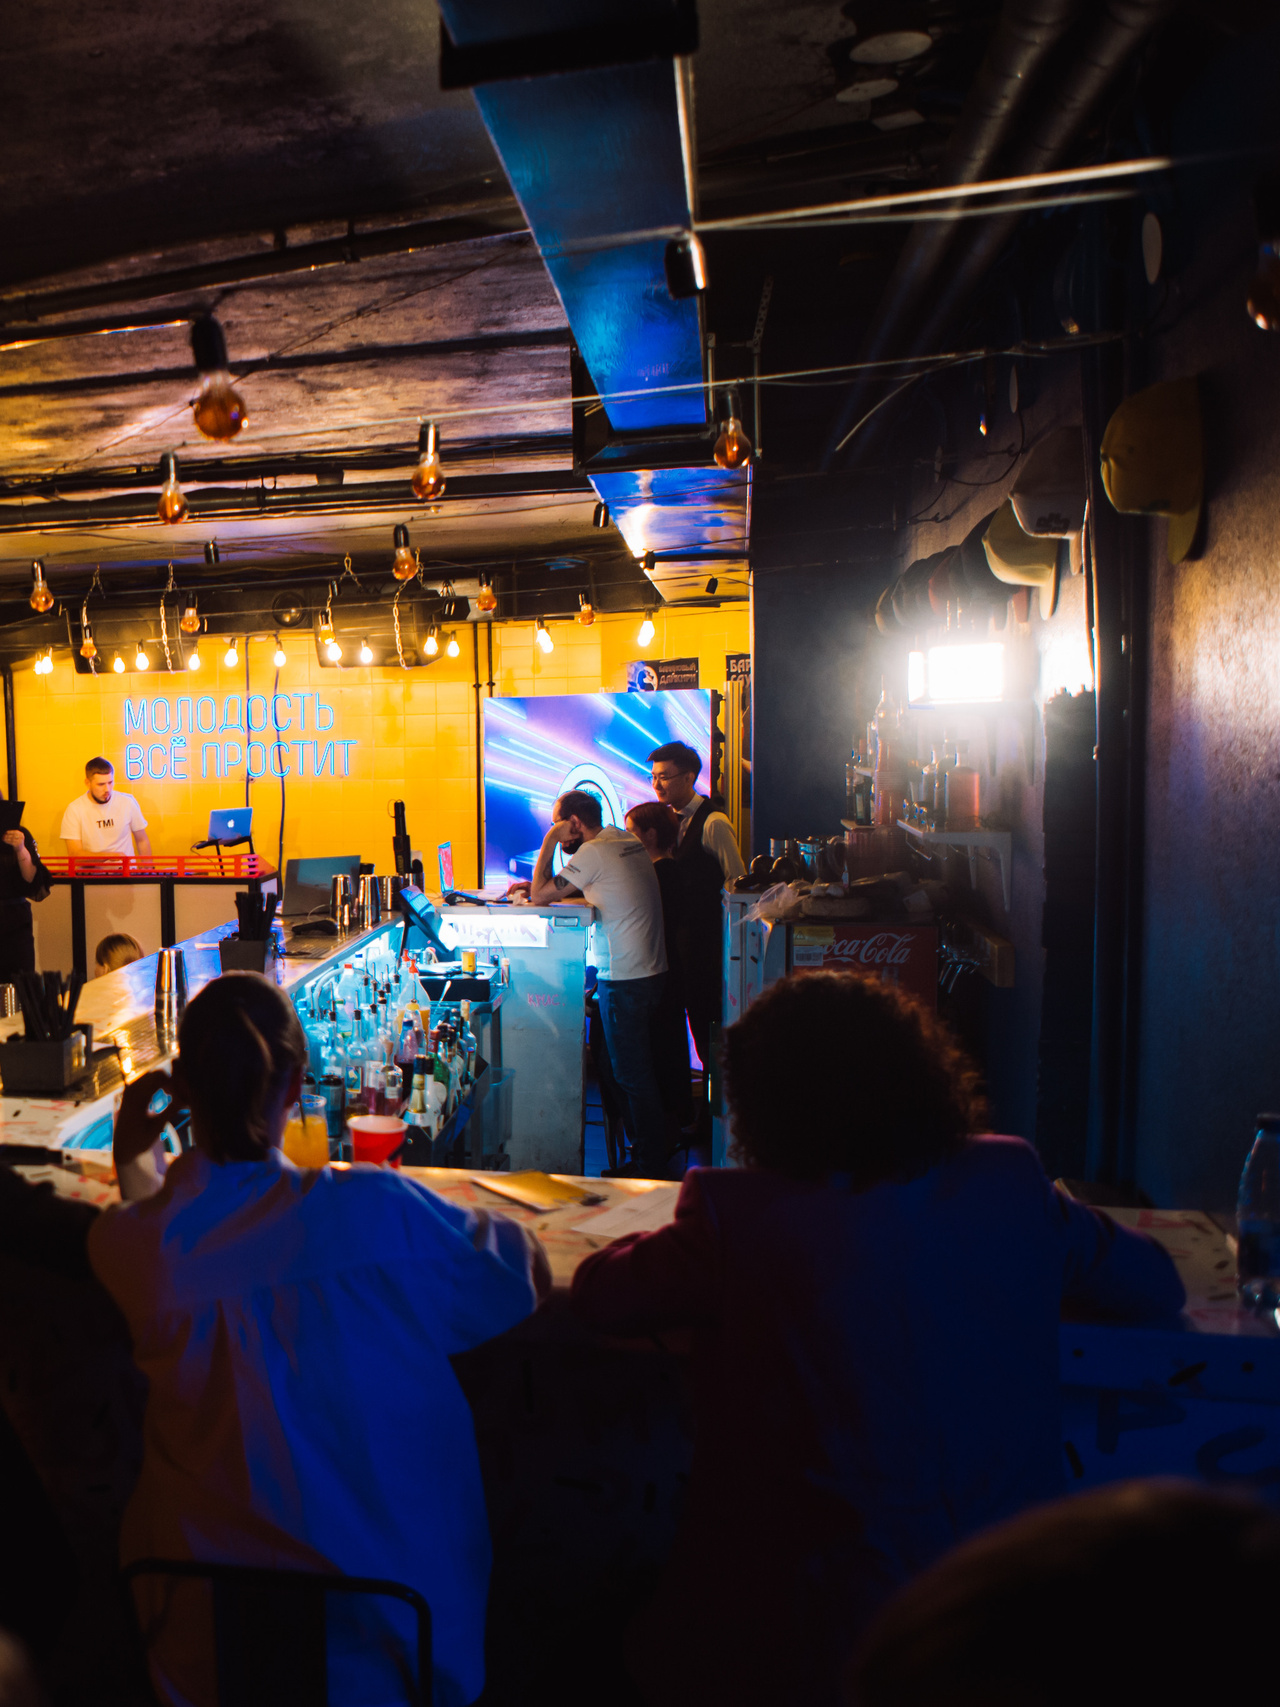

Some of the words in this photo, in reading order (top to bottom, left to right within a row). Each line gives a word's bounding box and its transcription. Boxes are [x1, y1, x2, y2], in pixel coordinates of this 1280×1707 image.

[124, 692, 334, 735] МОЛОДОСТЬ
[125, 736, 188, 780] ВСЁ
[202, 739, 358, 779] ПРОСТИТ
[823, 932, 917, 964] oca-Cola
